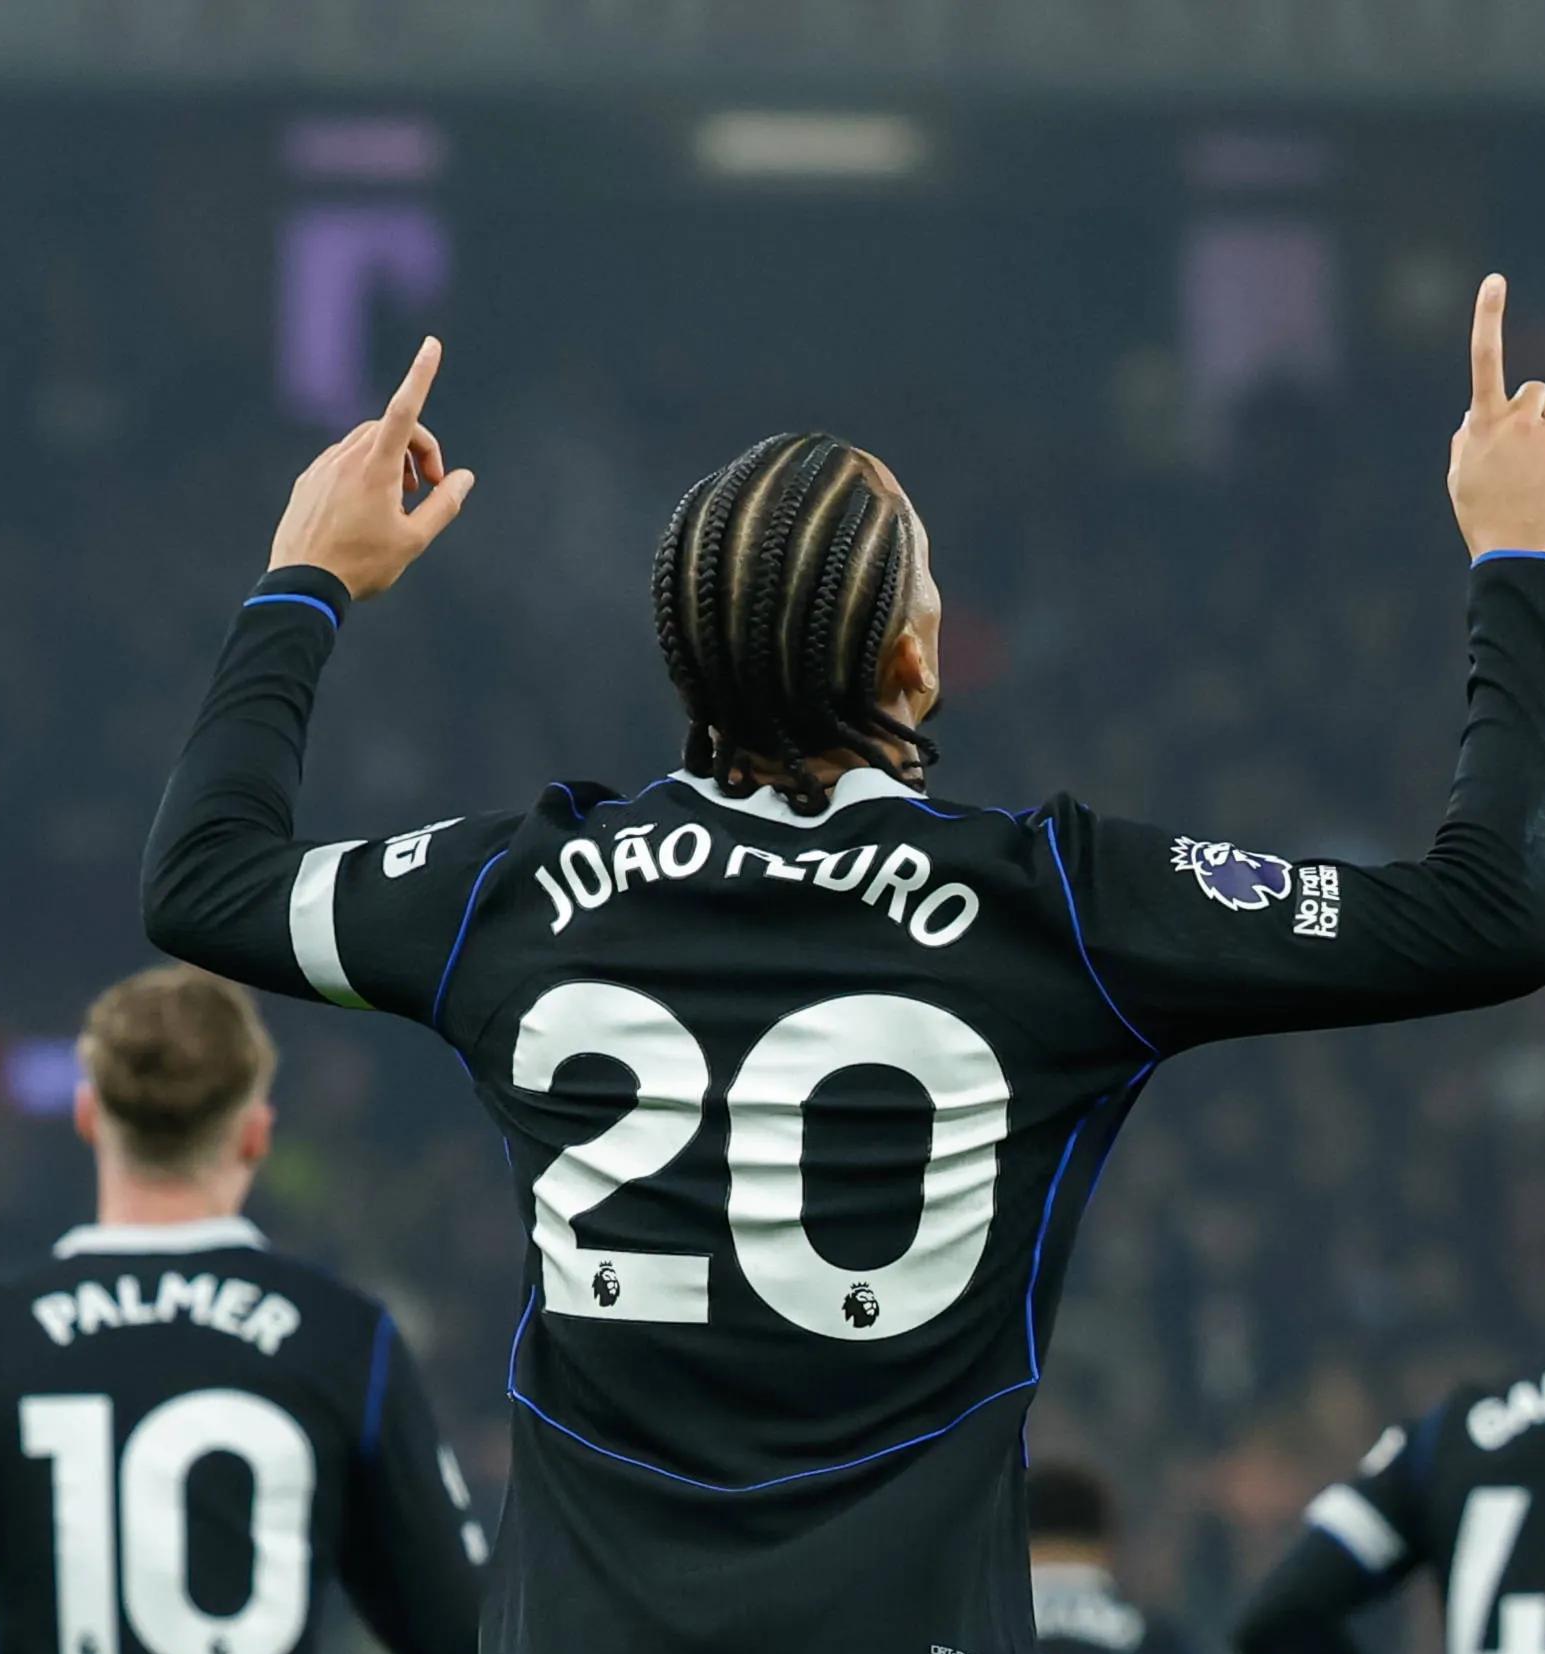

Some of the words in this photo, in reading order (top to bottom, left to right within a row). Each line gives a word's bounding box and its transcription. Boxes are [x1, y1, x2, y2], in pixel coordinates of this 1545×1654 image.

[534, 823, 713, 935] JOÃO
[512, 980, 1013, 1341] 20
[31, 1270, 302, 1357] PALMER
